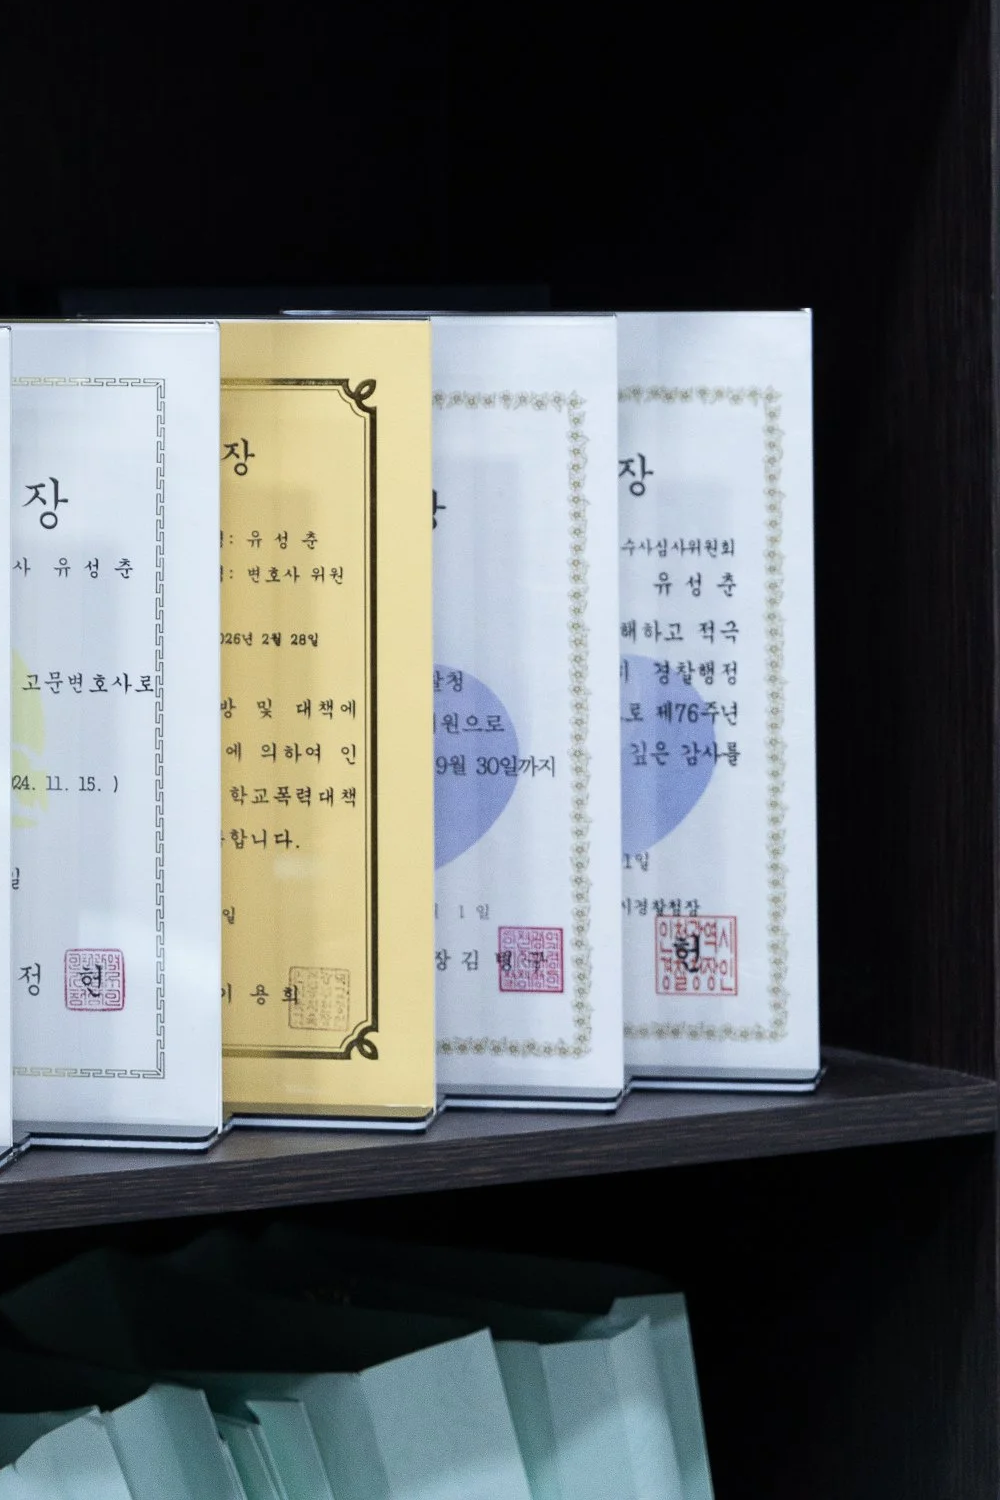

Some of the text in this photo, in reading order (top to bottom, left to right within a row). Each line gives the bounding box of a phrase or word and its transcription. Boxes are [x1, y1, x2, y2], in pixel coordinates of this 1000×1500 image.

[221, 438, 255, 476] 장
[619, 453, 653, 497] 장
[24, 477, 68, 529] 장
[621, 538, 734, 558] 수사심사위원회
[13, 557, 30, 576] 사
[248, 566, 300, 583] 변호사
[311, 566, 343, 584] 위원
[262, 633, 318, 647] 2월 28일
[700, 620, 739, 643] 적극
[23, 672, 153, 694] 고문변호사로
[653, 660, 736, 687] 경찰행정
[257, 698, 355, 719] 및 대책에
[655, 699, 737, 726] 제76주년
[226, 742, 355, 765] 에 의하여 인
[682, 741, 740, 767] 감사를
[476, 756, 554, 778] 30일까지
[46, 776, 100, 791] 11. 15.
[230, 785, 356, 807] 학교폭력대책
[462, 950, 478, 971] 김
[19, 963, 40, 996] 정
[250, 984, 269, 1005] 용
